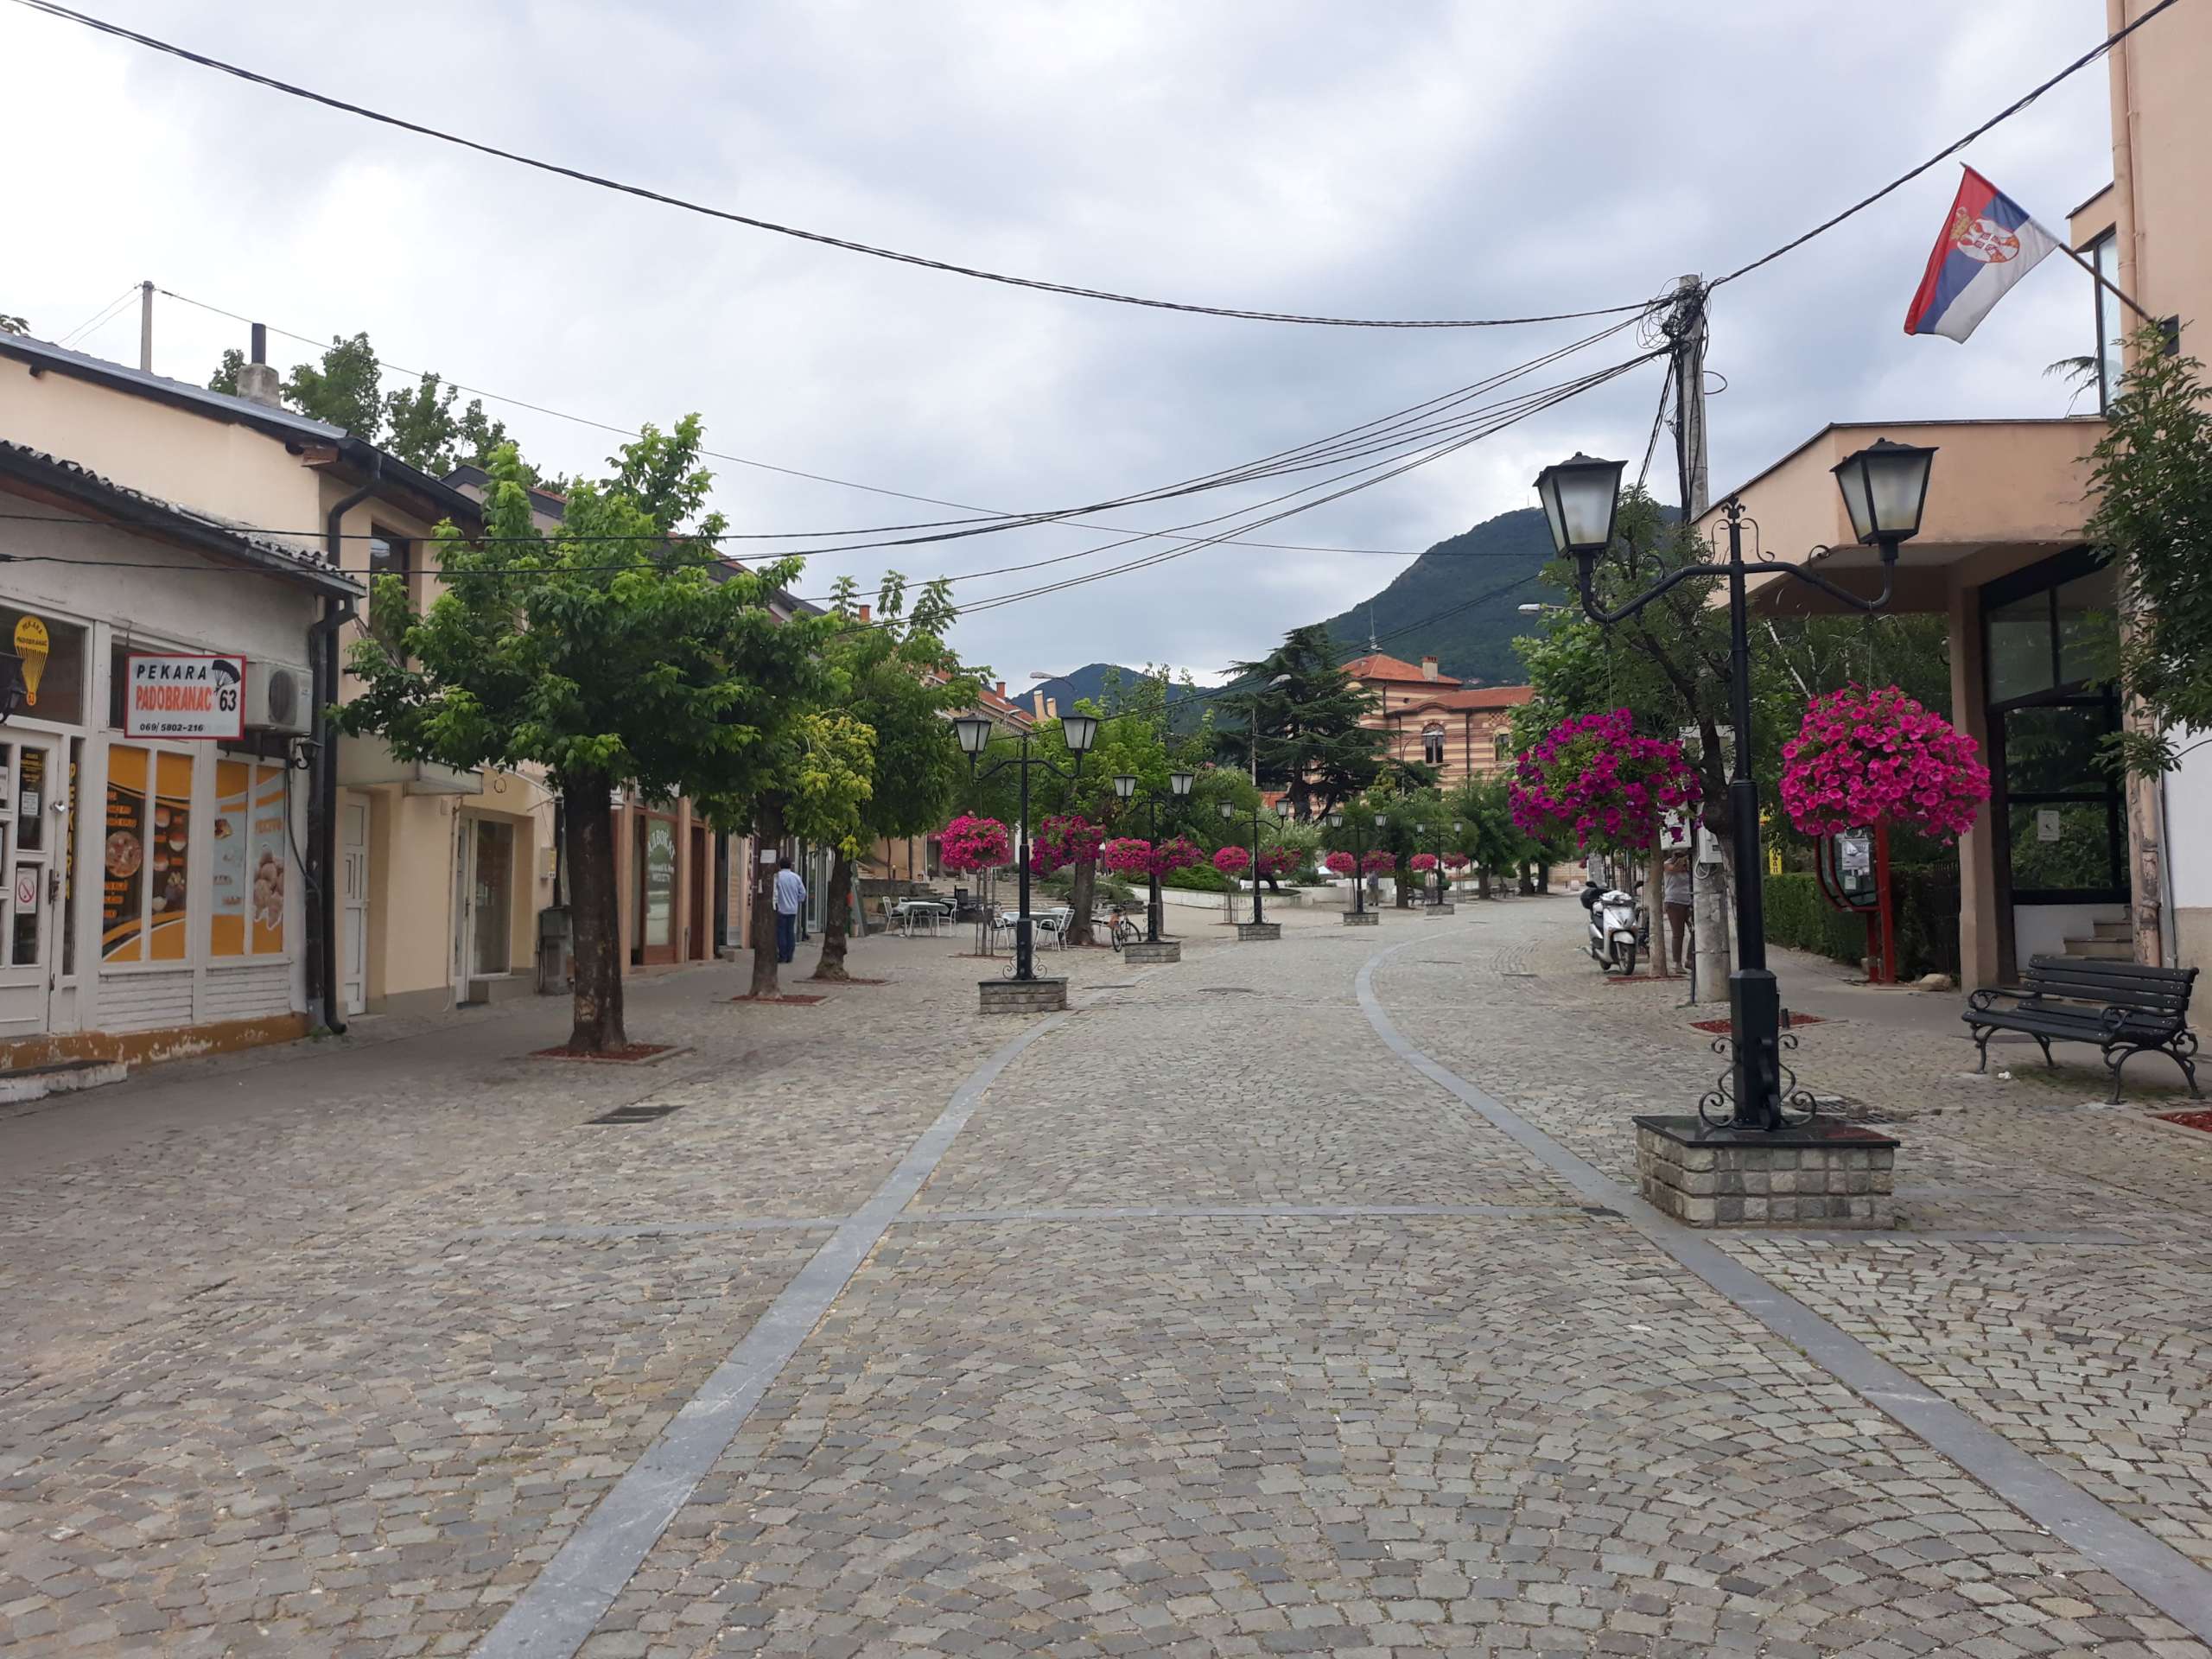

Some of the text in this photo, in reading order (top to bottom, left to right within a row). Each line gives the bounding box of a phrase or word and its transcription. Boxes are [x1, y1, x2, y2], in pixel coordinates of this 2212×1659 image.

[137, 664, 207, 680] PEKARA
[136, 685, 238, 712] PADOBRANAC 63
